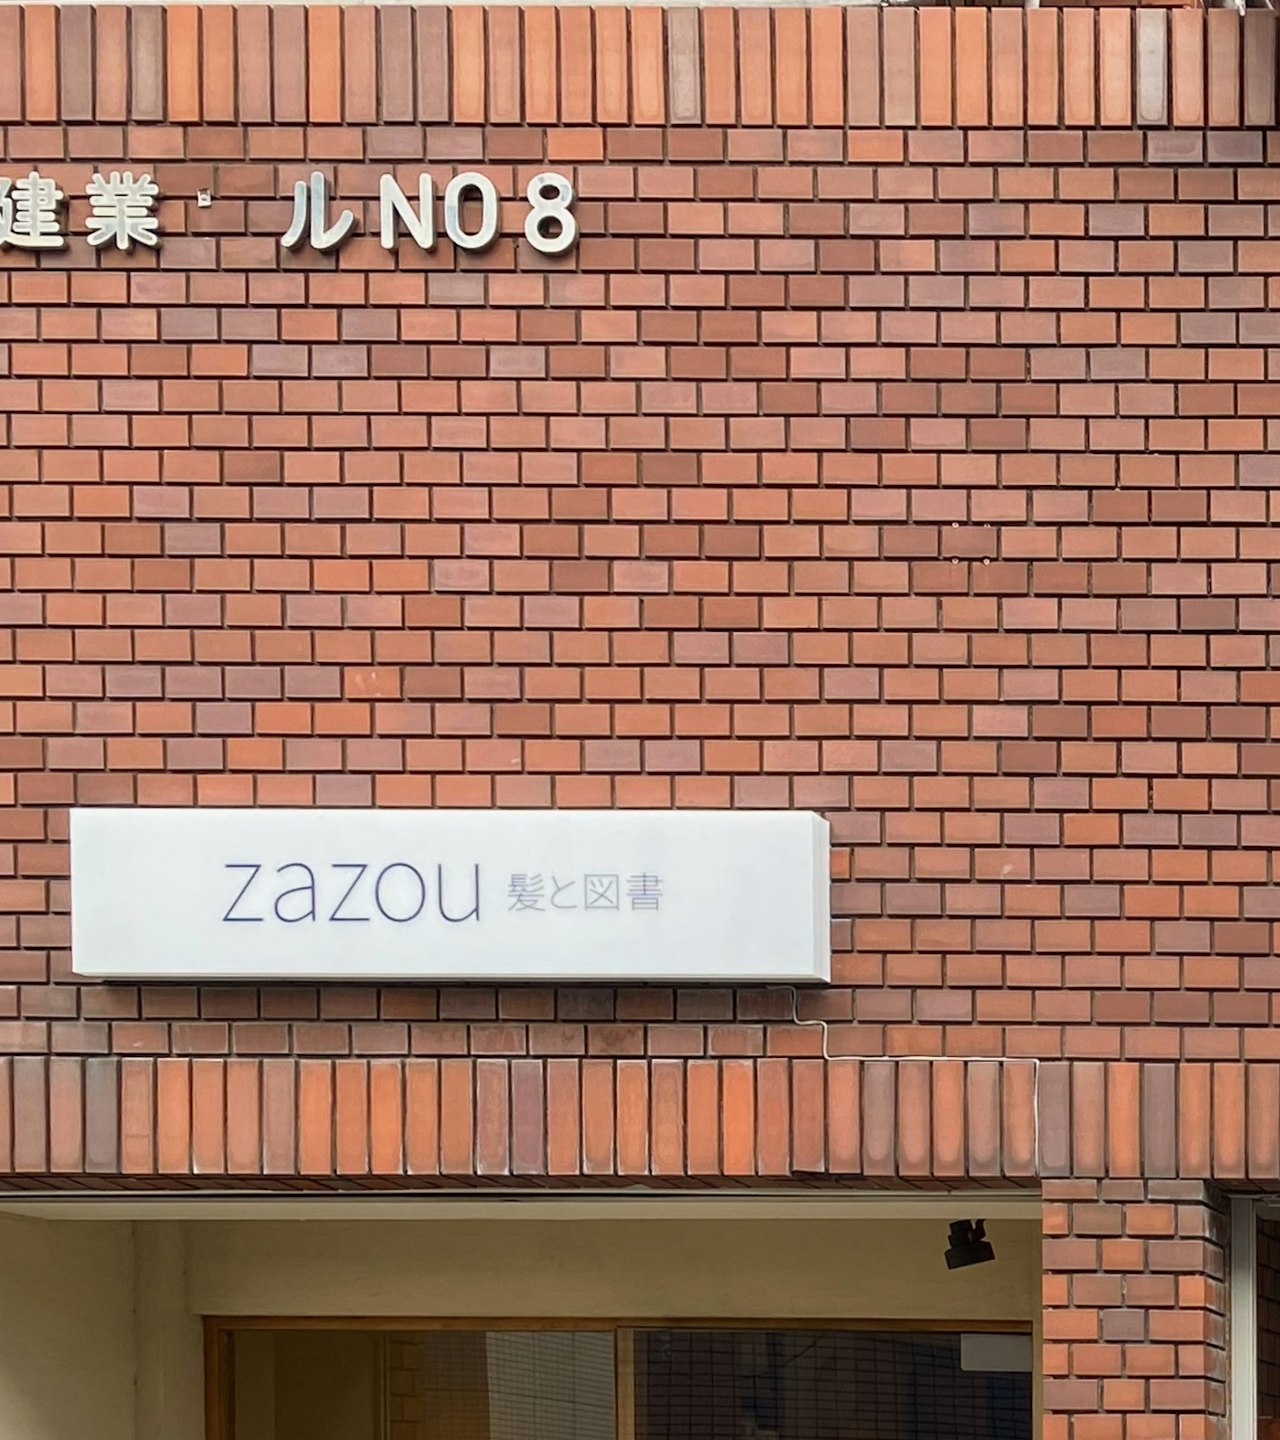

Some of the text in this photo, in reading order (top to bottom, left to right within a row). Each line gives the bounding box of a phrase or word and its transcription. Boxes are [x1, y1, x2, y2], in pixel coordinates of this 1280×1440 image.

[222, 862, 663, 923] zazou 髪と図書
